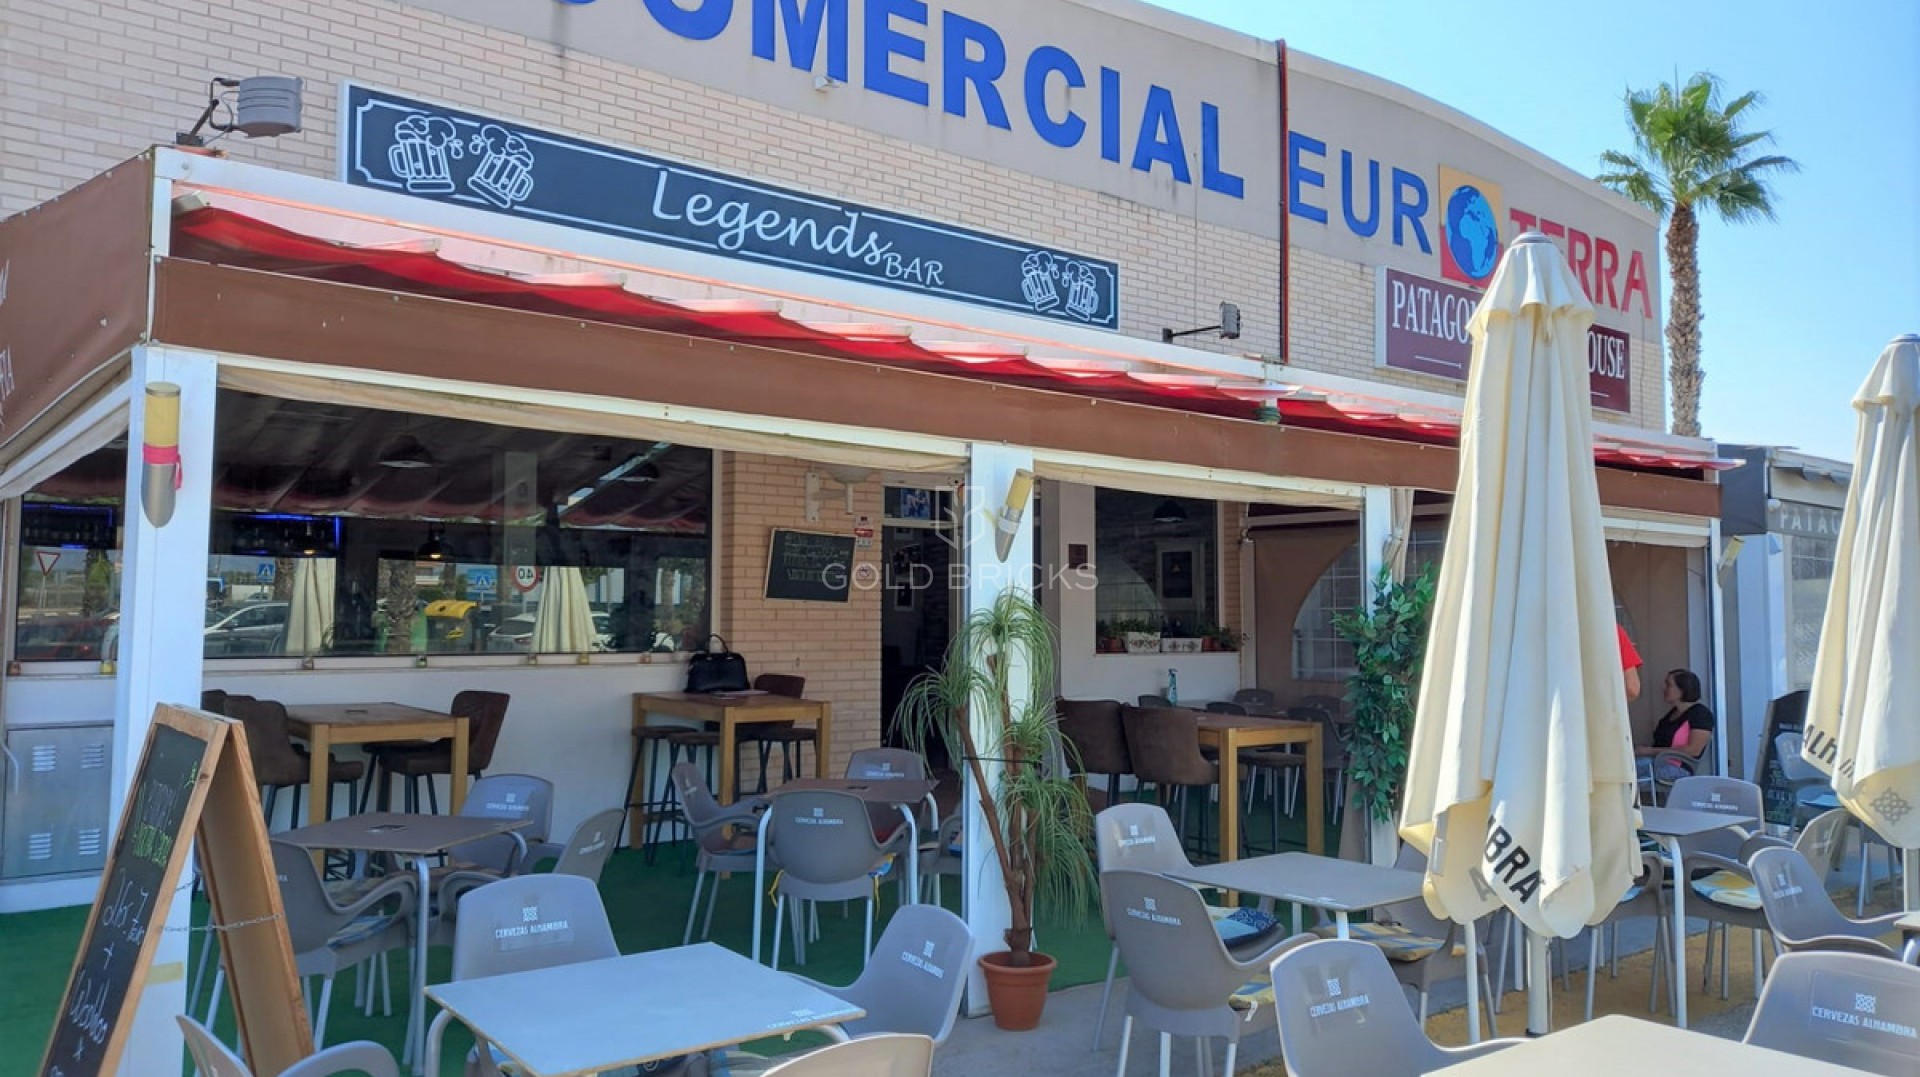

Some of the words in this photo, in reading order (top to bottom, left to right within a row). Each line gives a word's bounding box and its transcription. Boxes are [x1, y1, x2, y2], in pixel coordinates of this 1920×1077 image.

[553, 0, 1244, 199] MERCIAL
[883, 251, 945, 287] BAR
[1588, 330, 1625, 380] OUSE
[1485, 815, 1545, 904] BRA
[1812, 1006, 1860, 1026] CERVEZAS
[1862, 1016, 1918, 1039] ALHAMBRA
